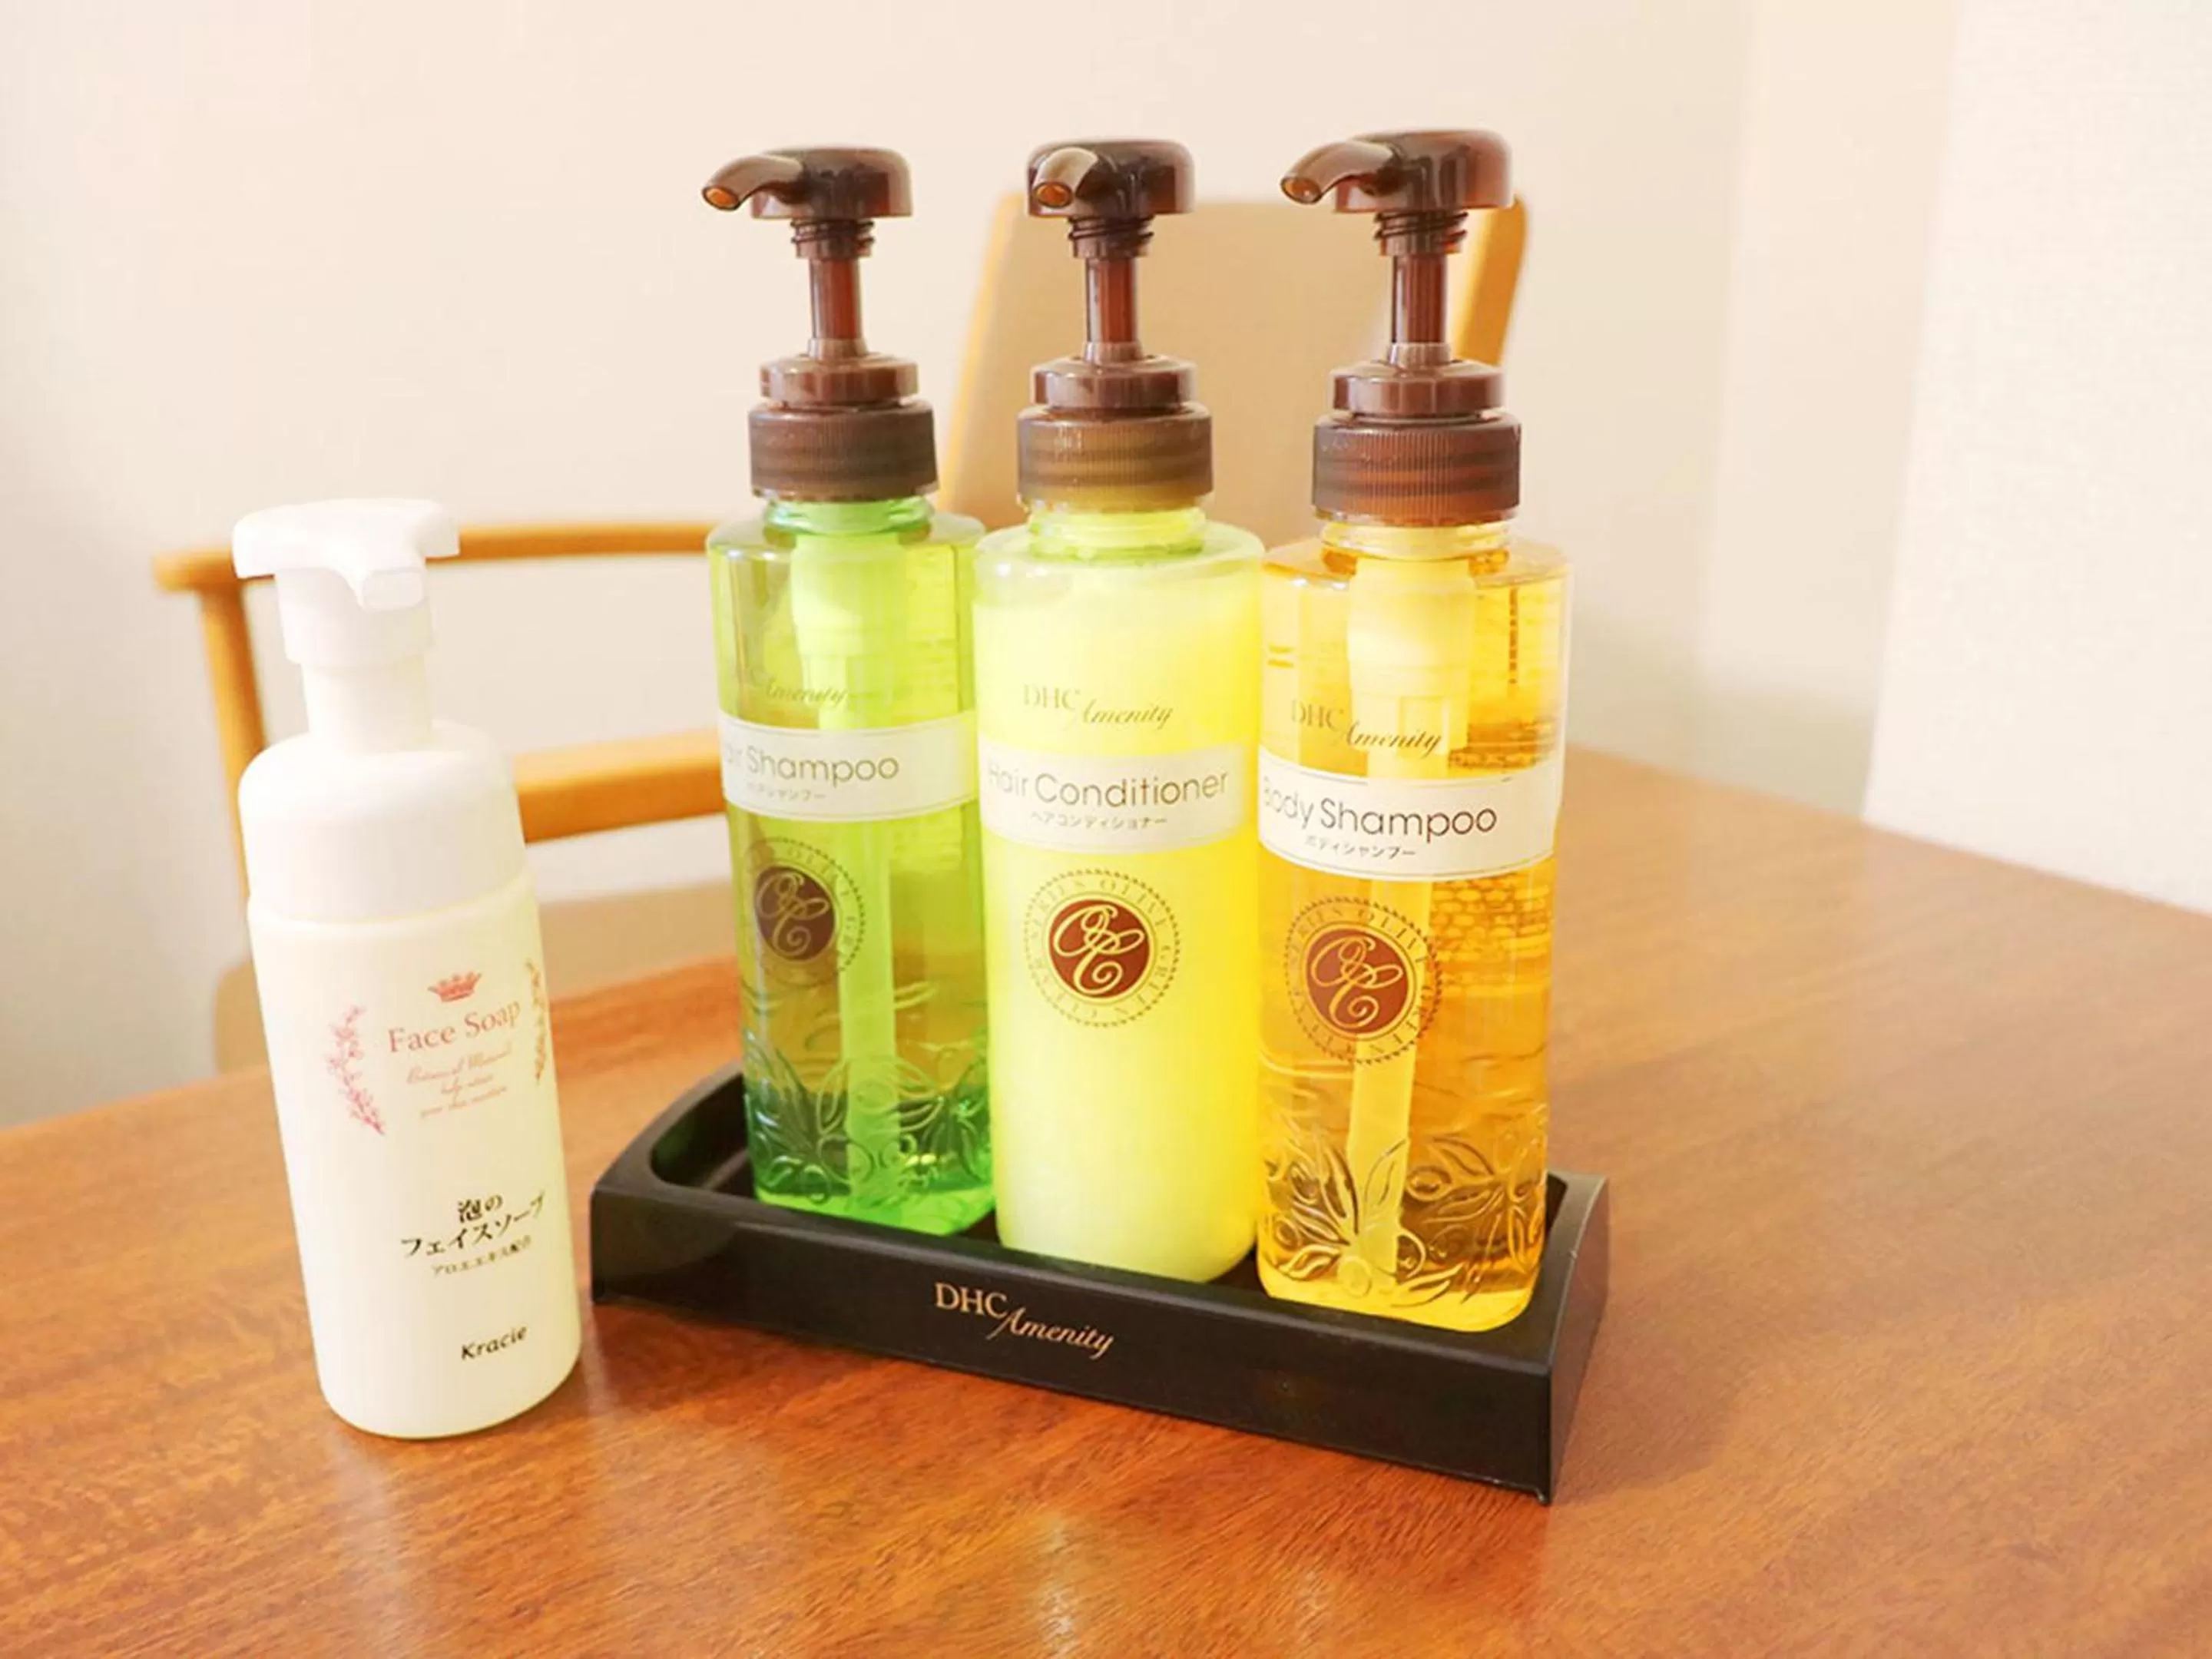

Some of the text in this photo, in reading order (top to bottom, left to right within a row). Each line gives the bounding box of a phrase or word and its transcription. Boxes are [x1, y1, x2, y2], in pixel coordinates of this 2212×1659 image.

[1022, 684, 1174, 730] DHC Amenity
[1291, 699, 1442, 760] DHC Amenity
[746, 743, 899, 788] Shampoo
[988, 757, 1228, 808] Hair Conditioner
[1320, 796, 1498, 844] Shampoo
[388, 1000, 522, 1054] Face Soap
[457, 1194, 503, 1224] 泡の
[461, 1326, 528, 1359] Kracie
[935, 1282, 1114, 1361] DHC Amenity
